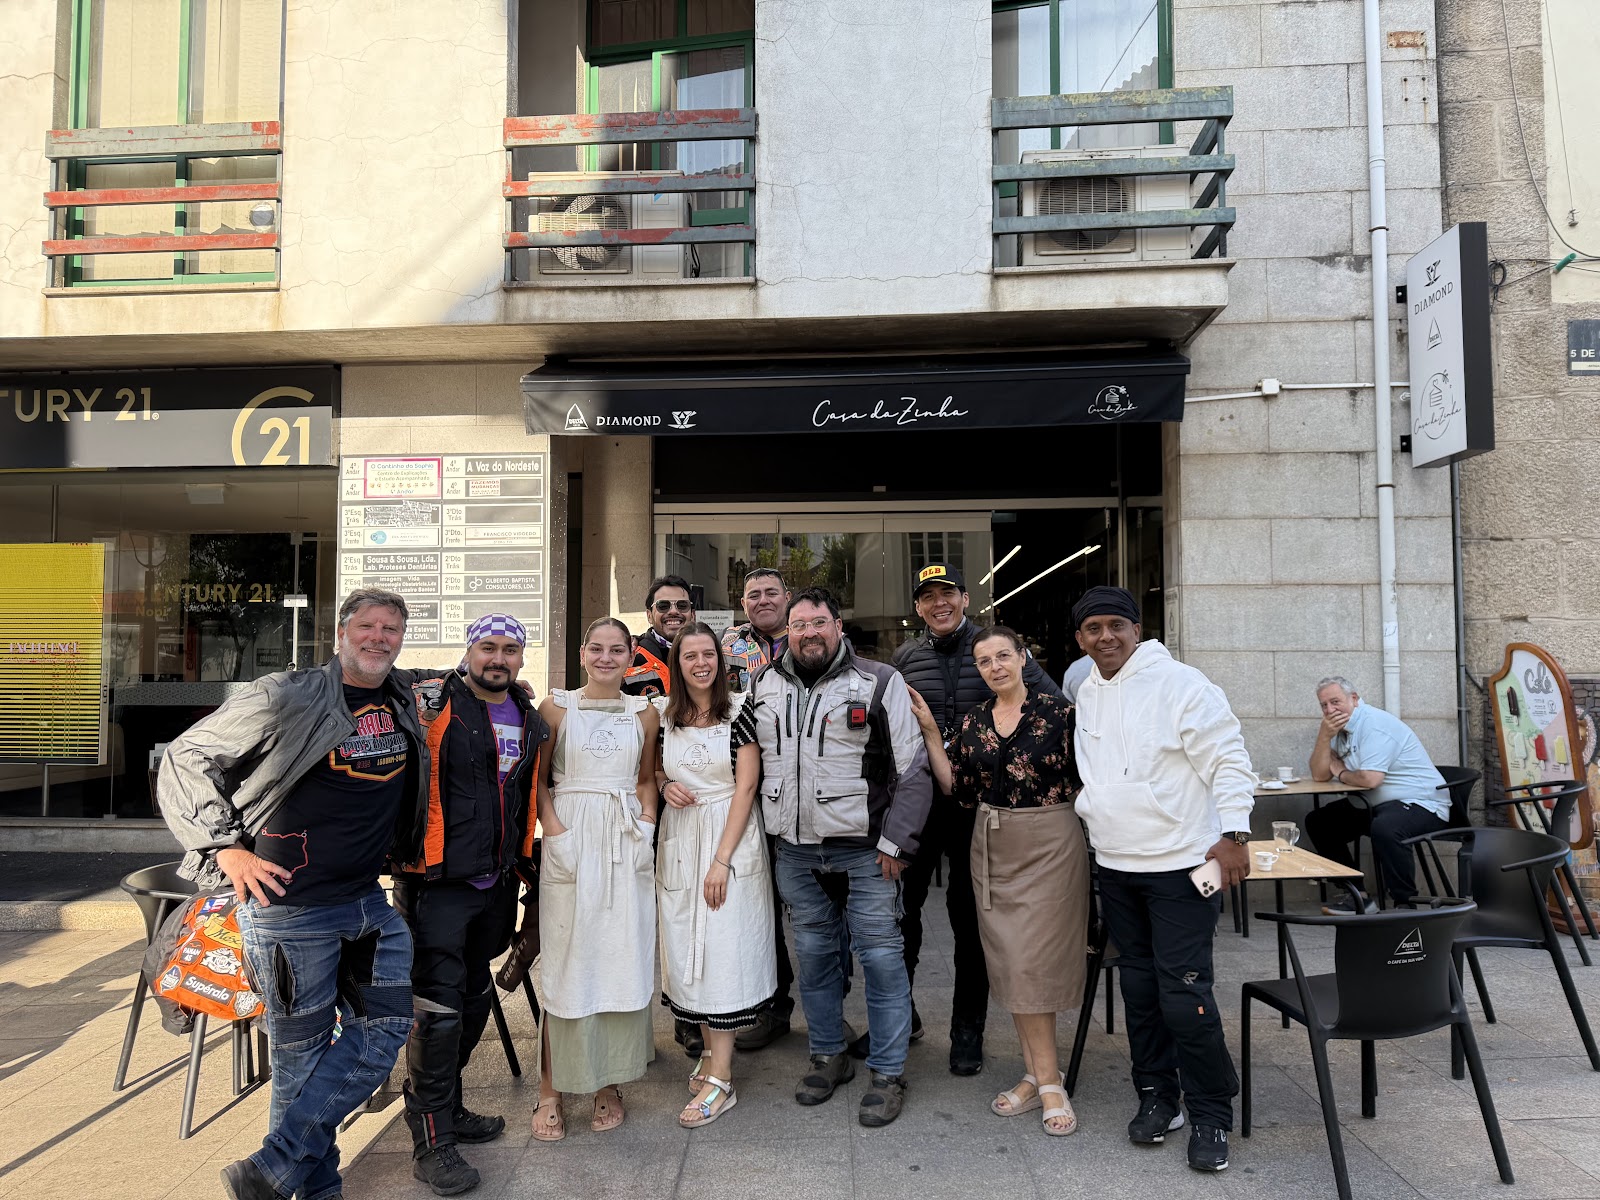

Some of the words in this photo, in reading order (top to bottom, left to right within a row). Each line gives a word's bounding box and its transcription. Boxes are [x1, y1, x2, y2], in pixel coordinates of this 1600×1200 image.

[1414, 281, 1454, 315] DIAMOND
[1570, 349, 1577, 358] 5
[1581, 349, 1596, 358] DE
[812, 399, 867, 427] Casa
[870, 400, 899, 419] da
[896, 395, 969, 425] Zinha
[596, 415, 662, 427] DIAMOND
[259, 416, 311, 466] 21
[466, 461, 473, 472] A
[475, 461, 490, 472] Voz
[492, 461, 502, 472] do
[505, 460, 540, 472] Nordeste
[366, 555, 388, 564] Sousa
[389, 555, 395, 563] &
[396, 555, 420, 564] Sousa,
[421, 554, 436, 563] Lda.
[922, 567, 942, 578] BLB
[357, 712, 395, 739] RALLY
[186, 976, 230, 1001] Supéralo
